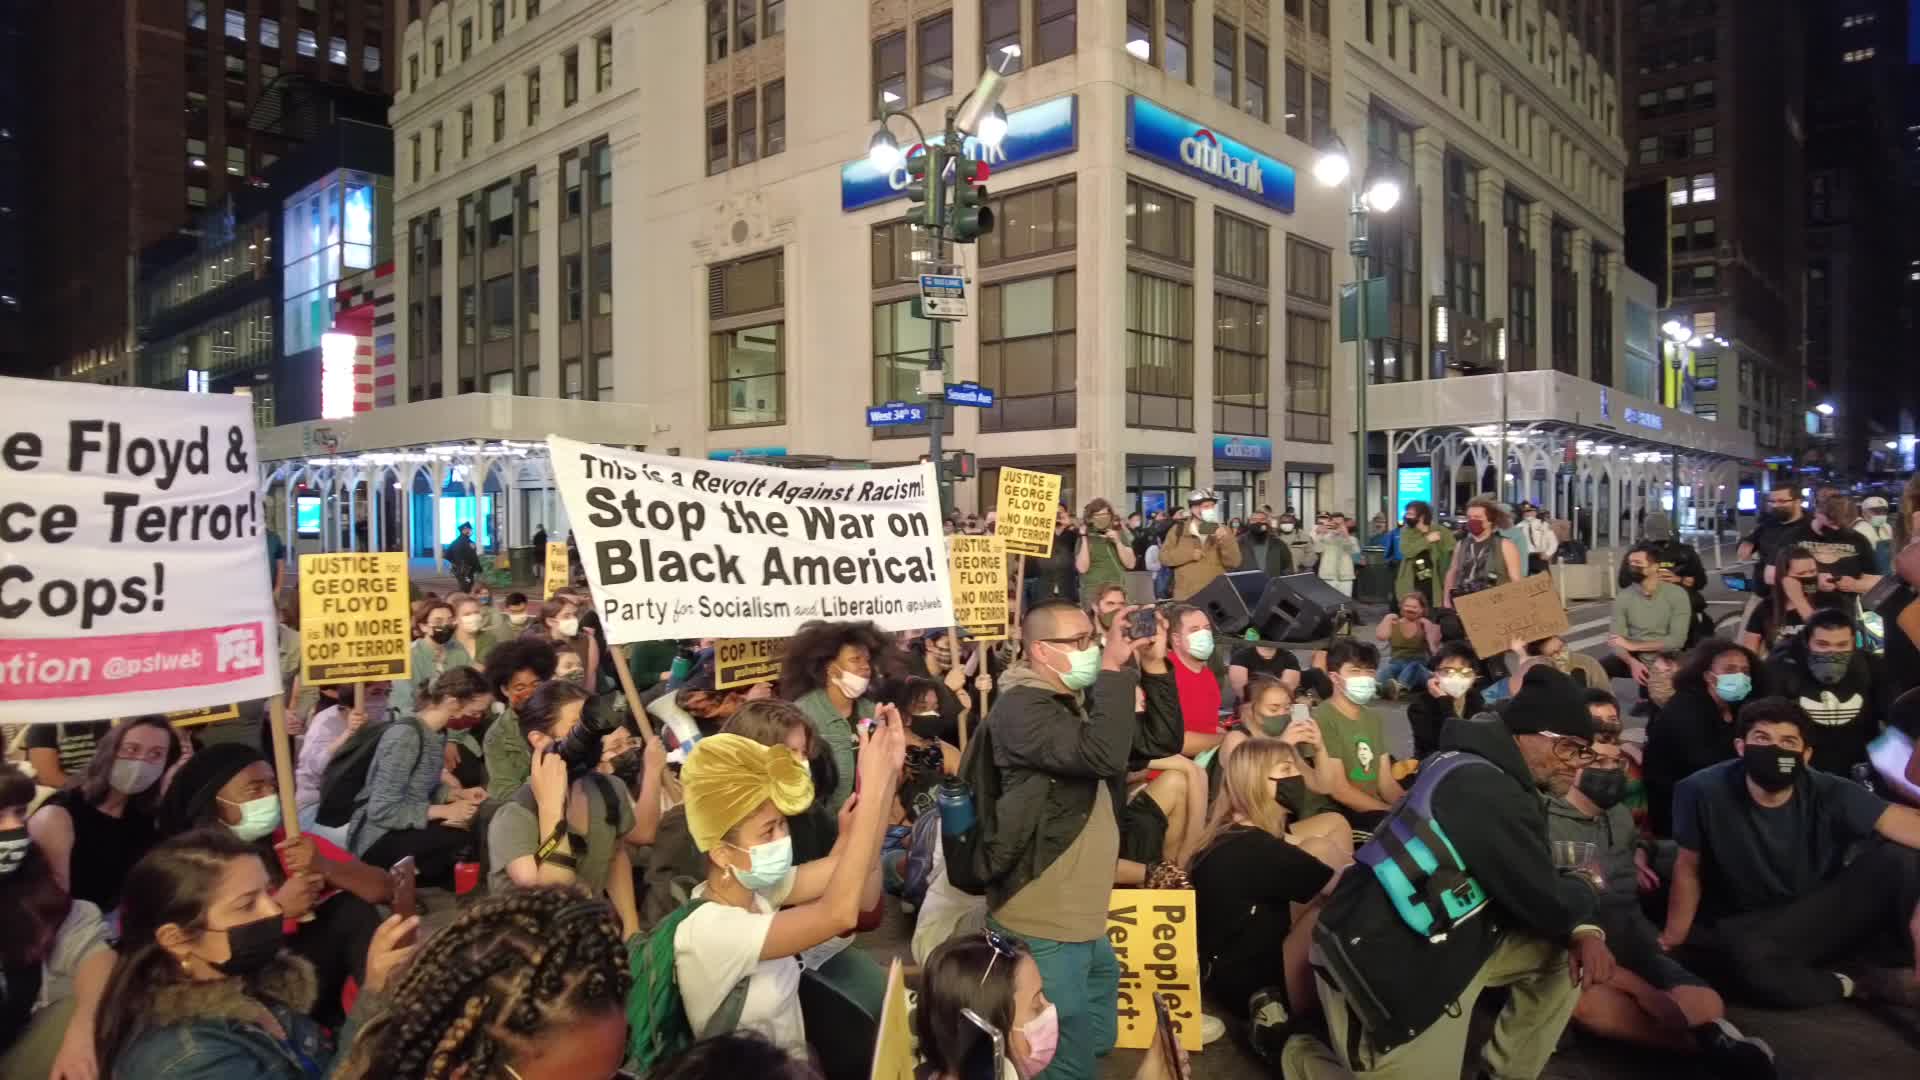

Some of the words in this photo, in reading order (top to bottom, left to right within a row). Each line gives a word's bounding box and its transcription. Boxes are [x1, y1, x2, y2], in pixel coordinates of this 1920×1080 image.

[1180, 133, 1264, 194] citibank
[947, 388, 977, 401] Seventh
[870, 411, 892, 421] West
[910, 408, 921, 419] St
[3, 431, 42, 471] e
[68, 420, 209, 490] Floyd
[225, 425, 248, 474] &
[580, 453, 637, 481] This
[642, 463, 664, 483] is
[671, 471, 684, 487] a
[692, 469, 768, 498] Revolt
[768, 480, 854, 504] Against
[857, 474, 925, 501] Racism!
[1003, 471, 1045, 487] JUSTICE
[1004, 485, 1053, 501] GEORGE
[585, 486, 706, 541] Stop
[720, 500, 789, 537] the
[796, 506, 875, 540] War
[888, 511, 929, 537] on
[1008, 497, 1045, 512] FLOYD
[0, 501, 78, 544] ce
[103, 490, 257, 543] Terror!
[1007, 512, 1020, 525] NO
[1024, 515, 1051, 529] MORE
[998, 525, 1014, 537] COP
[1017, 527, 1050, 541] TERROR
[954, 538, 990, 553] JUSTICE
[306, 556, 379, 575] JUSTICE
[595, 539, 747, 586] Black
[762, 546, 936, 586] America!
[955, 556, 1001, 570] GEORGE
[312, 577, 398, 595] GEORGE
[960, 571, 997, 585] FLOYD
[0, 562, 165, 629] Cops!
[322, 596, 388, 613] FLOYD
[961, 591, 976, 604] NO
[979, 590, 1005, 604] MORE
[604, 597, 667, 625] Party
[673, 598, 694, 623] for
[698, 595, 790, 618] Socialism
[821, 594, 903, 617] Liberation
[954, 608, 971, 621] COP
[974, 607, 1006, 621] TERROR
[324, 622, 348, 638] NO
[354, 618, 403, 636] MORE
[215, 628, 262, 673] PSL
[307, 642, 340, 661] COP
[346, 638, 405, 658] TERROR
[720, 642, 745, 662] COP
[0, 652, 91, 686] tion
[103, 648, 202, 680] @pslweb
